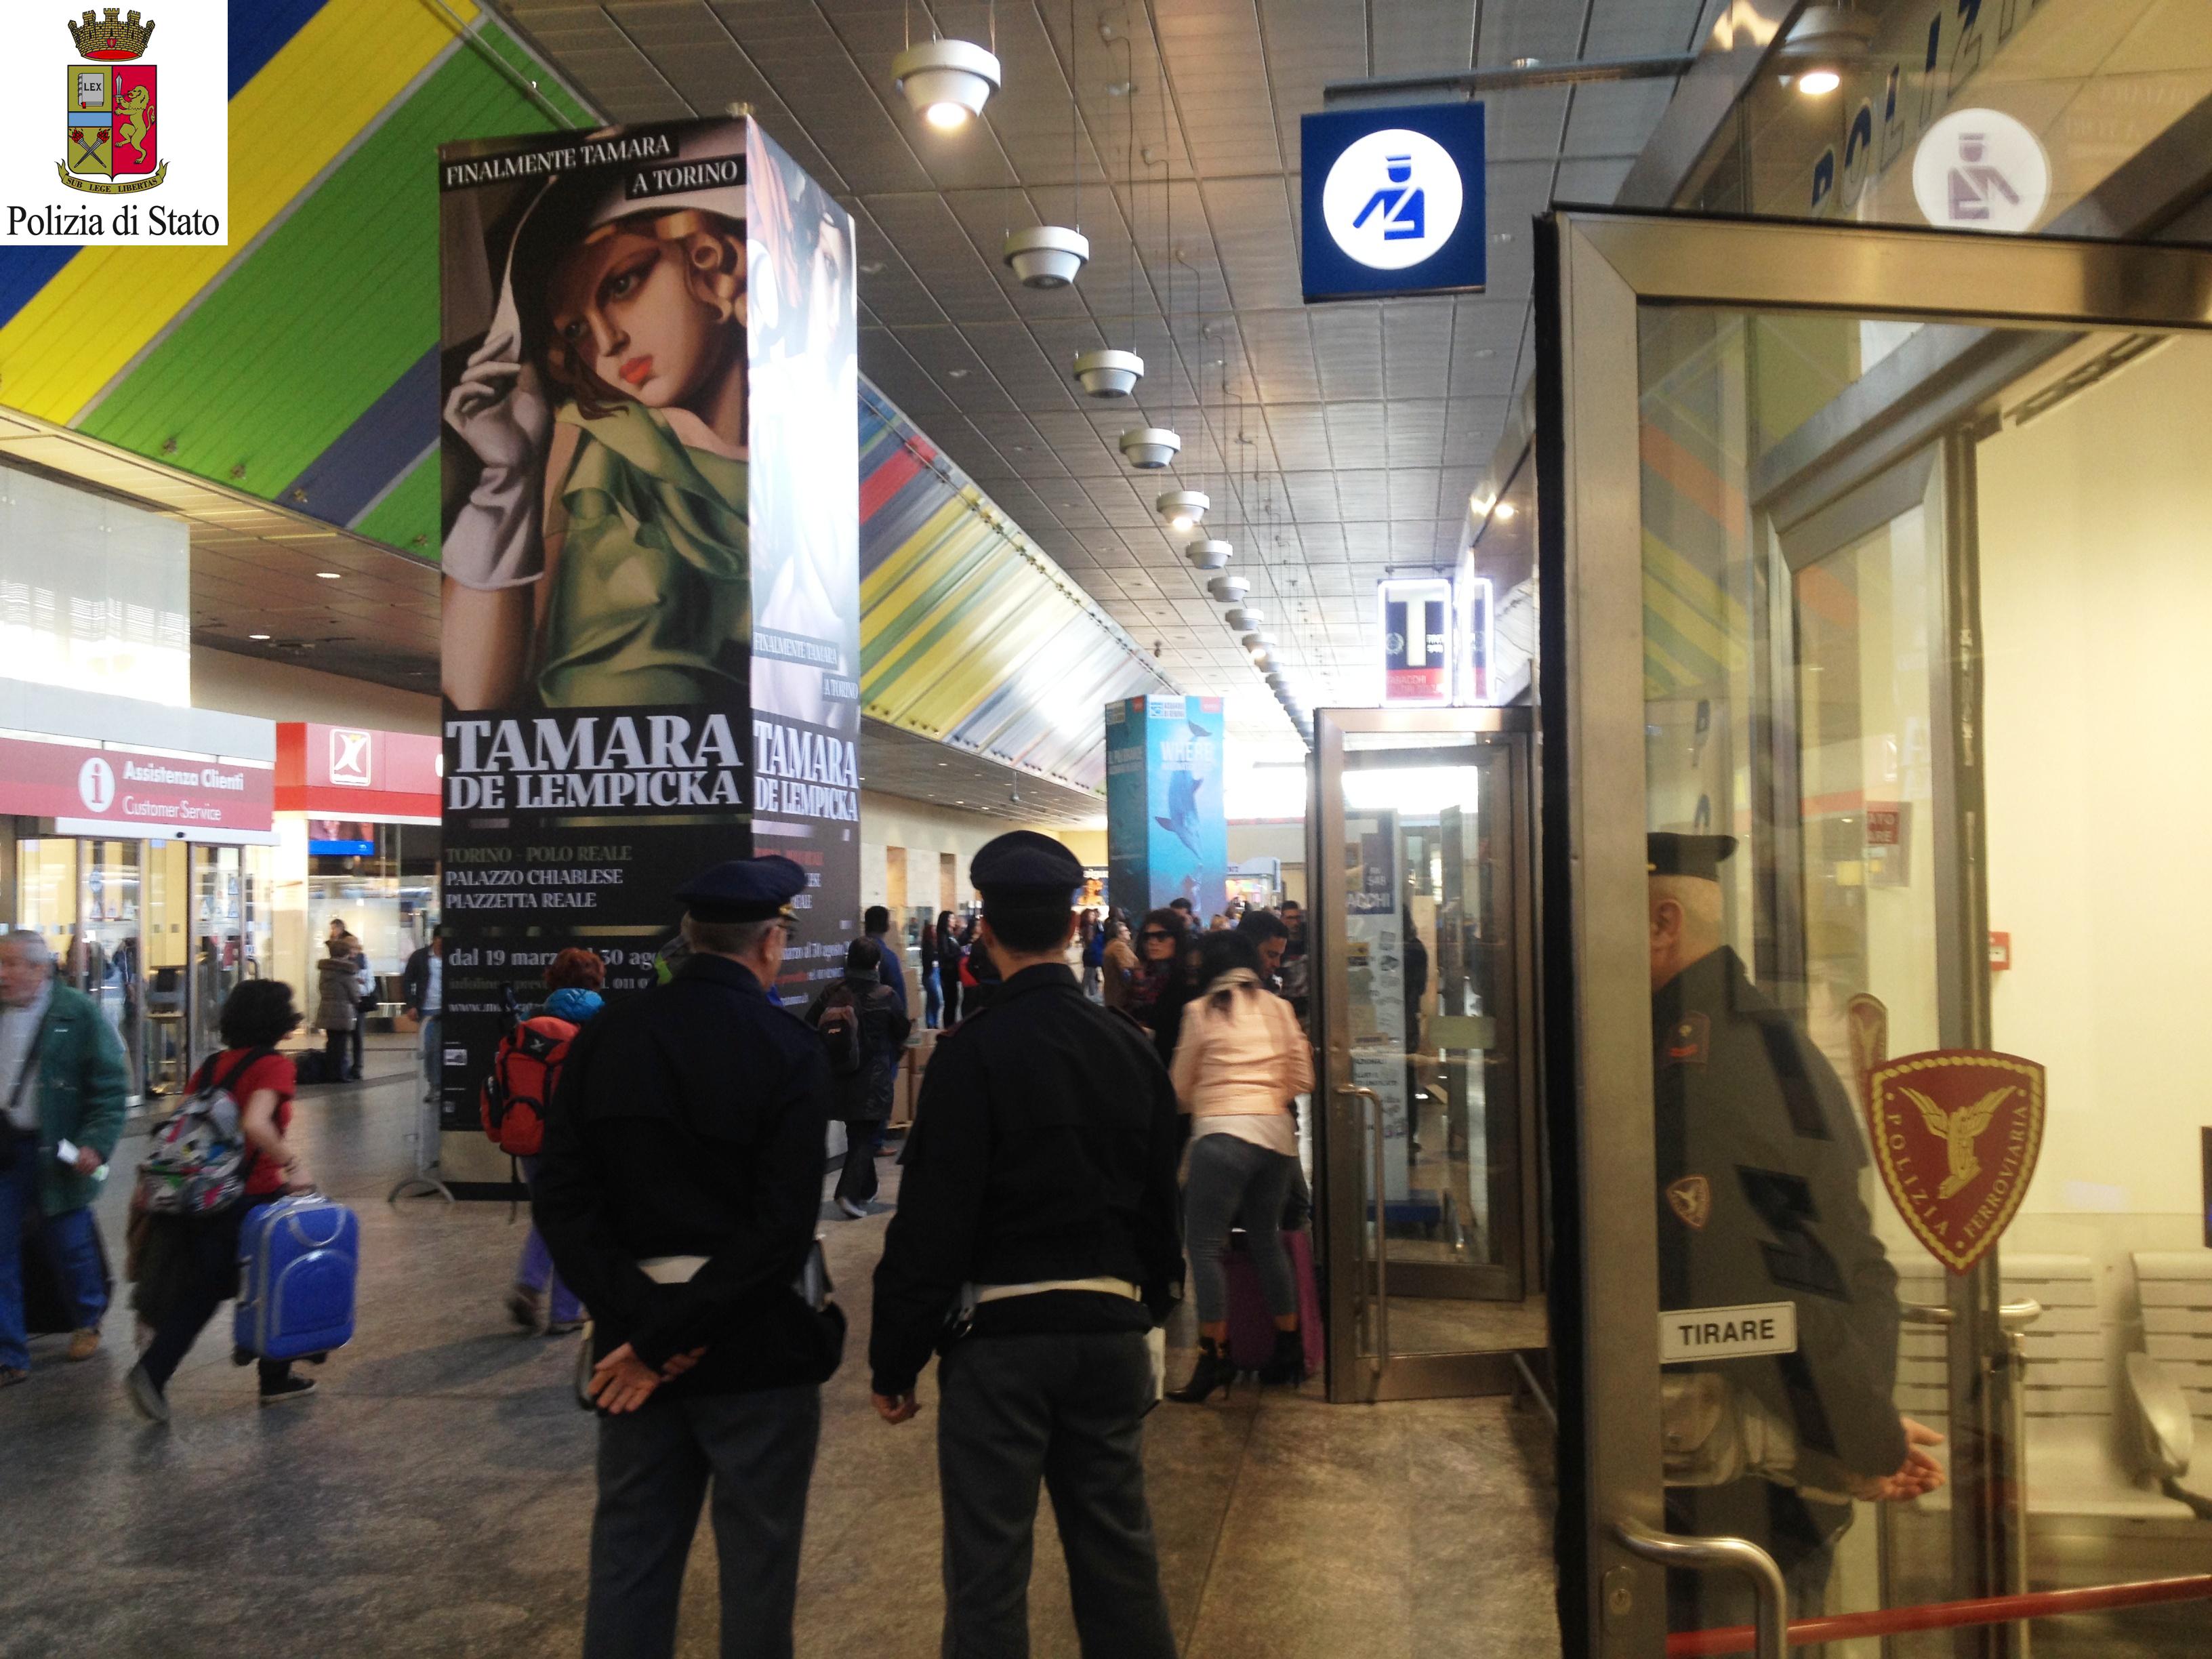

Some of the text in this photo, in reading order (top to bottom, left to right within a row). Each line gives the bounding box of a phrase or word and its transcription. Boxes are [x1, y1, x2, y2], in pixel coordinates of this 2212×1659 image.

[445, 134, 670, 186] FINALMENTE TAMARA
[633, 160, 739, 195] A TORINO
[753, 631, 838, 664] FINALMENTE TAMARA
[824, 678, 859, 699] A TORINO
[445, 714, 743, 773] TAMARA
[753, 720, 859, 789] TAMARA
[123, 760, 244, 791] Assistenza Clienti
[447, 770, 743, 810] DE LEMPICKA
[122, 796, 222, 821] Customer Service
[754, 776, 859, 822] DE LEMPICKA
[446, 847, 512, 863] TORINO
[526, 846, 574, 863] POLO
[577, 845, 633, 861] REALE
[445, 869, 623, 886] PALAZZO CHIABLESE
[445, 892, 598, 909] PIAZZETTA REALE
[449, 948, 478, 966] dal
[486, 949, 505, 966] 19
[510, 951, 558, 966] marz
[1887, 1113, 1950, 1236] POLIZIA
[1963, 1105, 2028, 1239] FERROVIARIA
[1678, 1318, 1775, 1346] TIRARE
